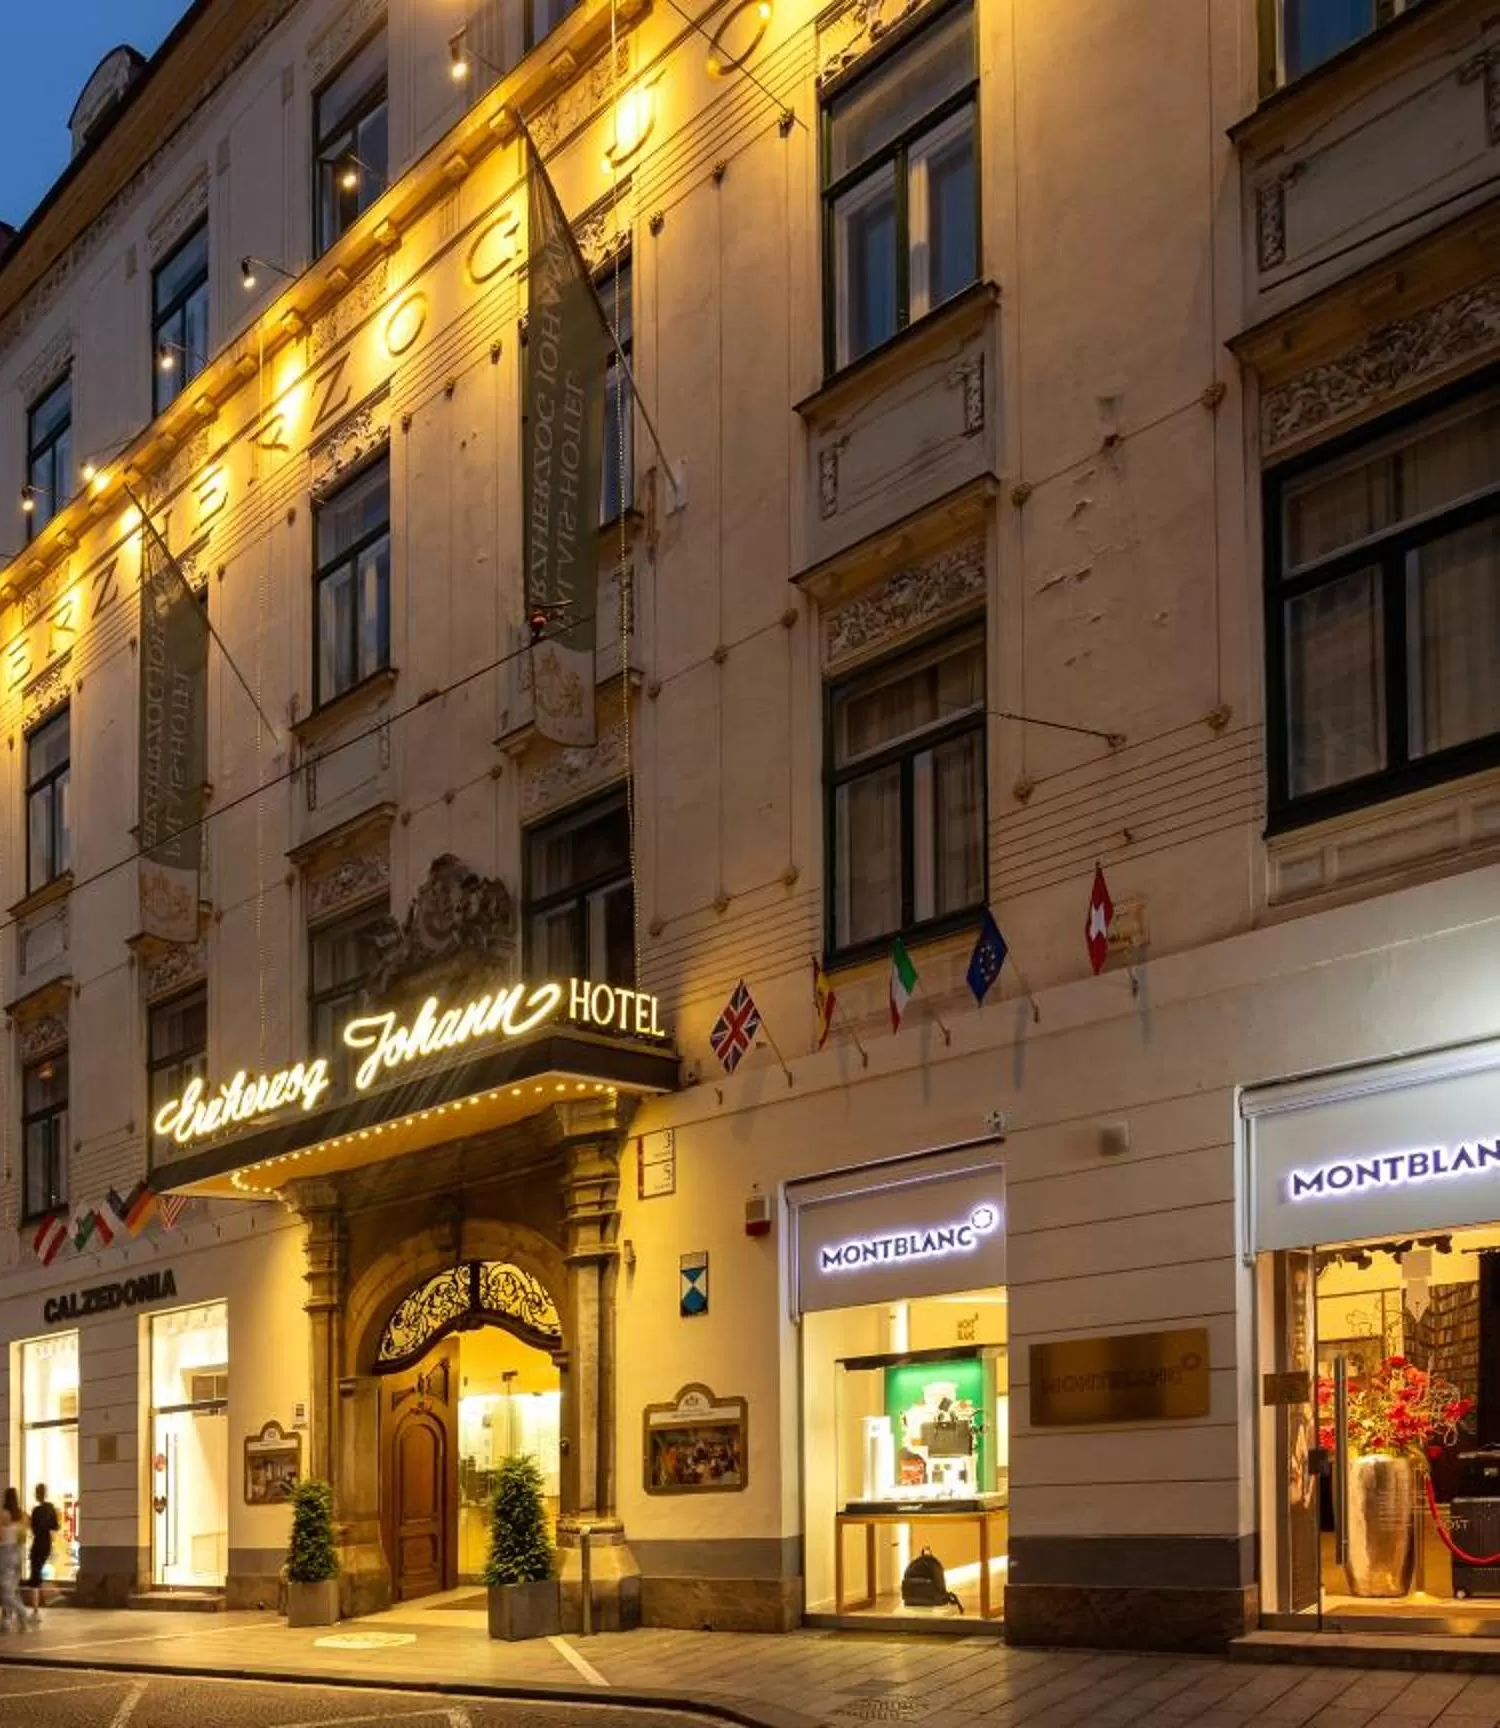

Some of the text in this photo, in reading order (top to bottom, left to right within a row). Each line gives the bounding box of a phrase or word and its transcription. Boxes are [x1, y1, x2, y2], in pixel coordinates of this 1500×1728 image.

[153, 977, 665, 1143] Erzherzog Johann HOTEL
[822, 1225, 973, 1269] MONTBLANC
[43, 1268, 178, 1324] CALZEDONIA
